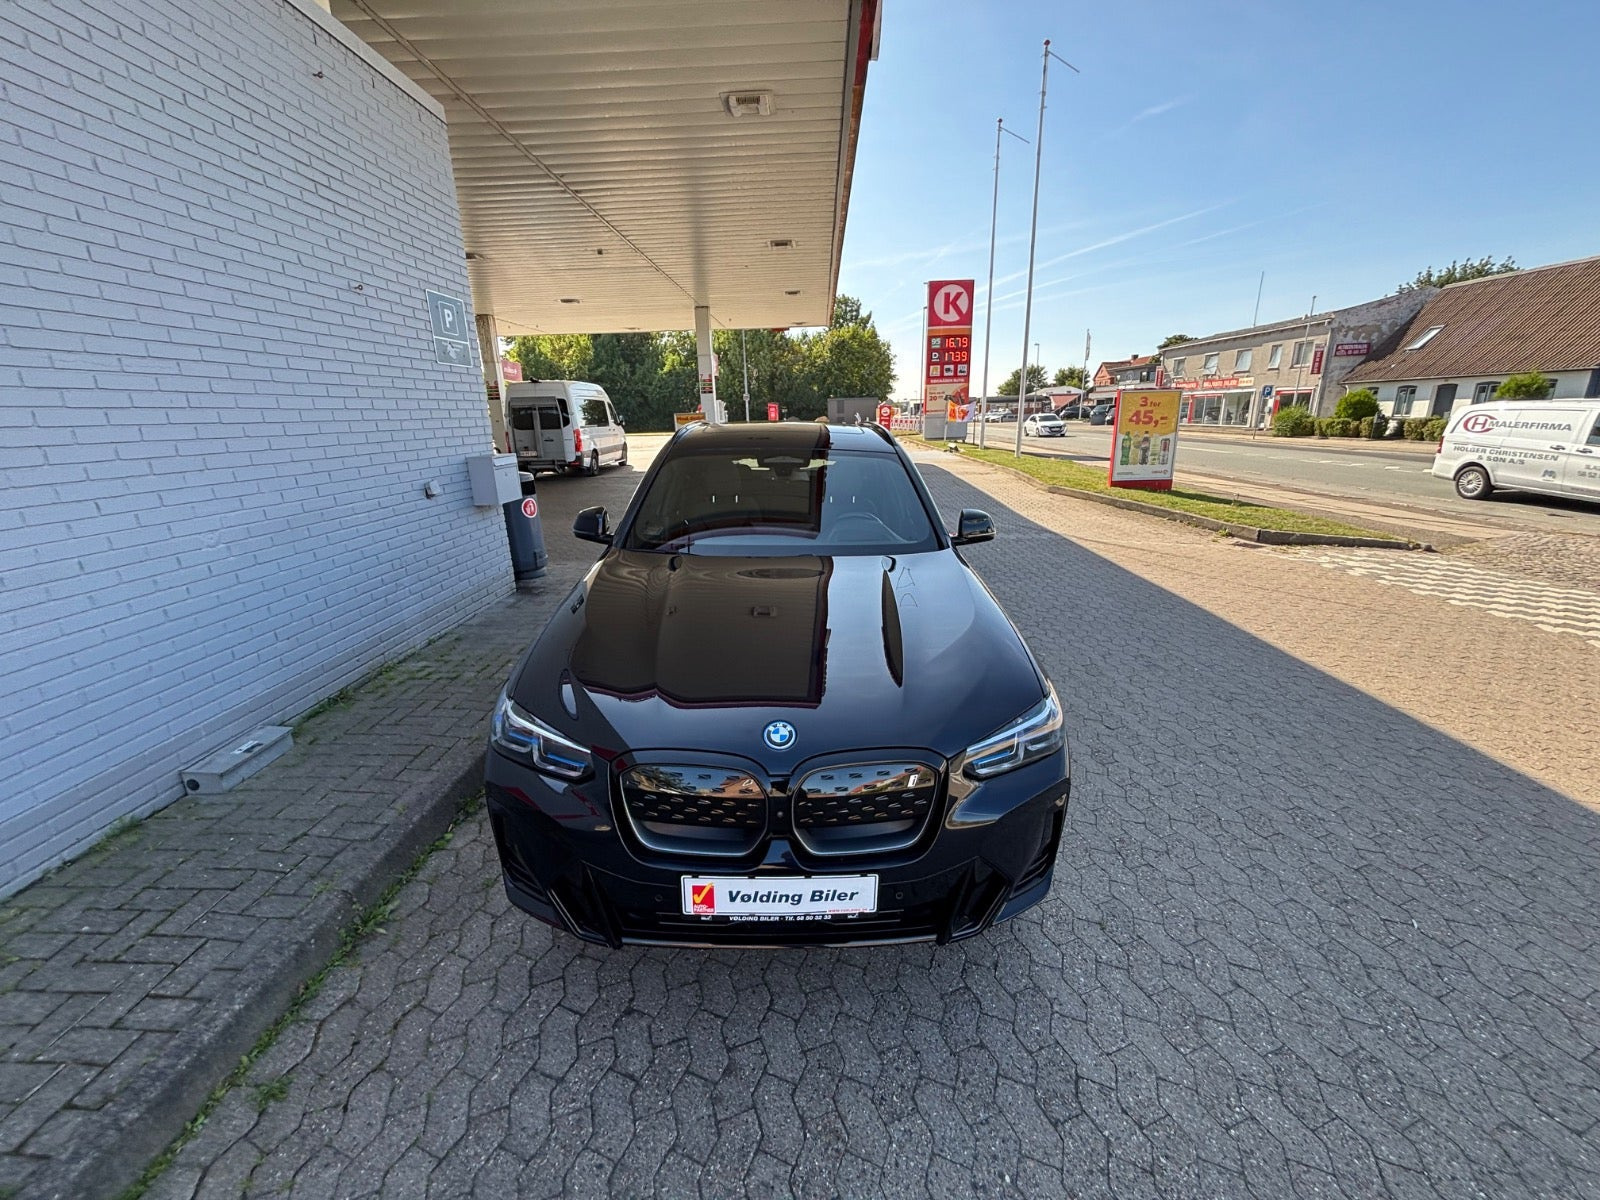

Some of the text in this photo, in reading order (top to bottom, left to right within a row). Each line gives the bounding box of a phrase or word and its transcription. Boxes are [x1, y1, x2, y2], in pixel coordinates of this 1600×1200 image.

[943, 291, 965, 315] K
[443, 308, 453, 329] P
[931, 337, 941, 345] 95
[1264, 386, 1272, 395] P
[1139, 396, 1148, 407] 3
[1488, 420, 1572, 432] MALERFIRMA
[1453, 445, 1560, 462] HOLGER CHRISTENSEN
[1485, 455, 1507, 463] SØN
[1507, 457, 1526, 465] A/S
[727, 889, 859, 906] Vølding Biler
